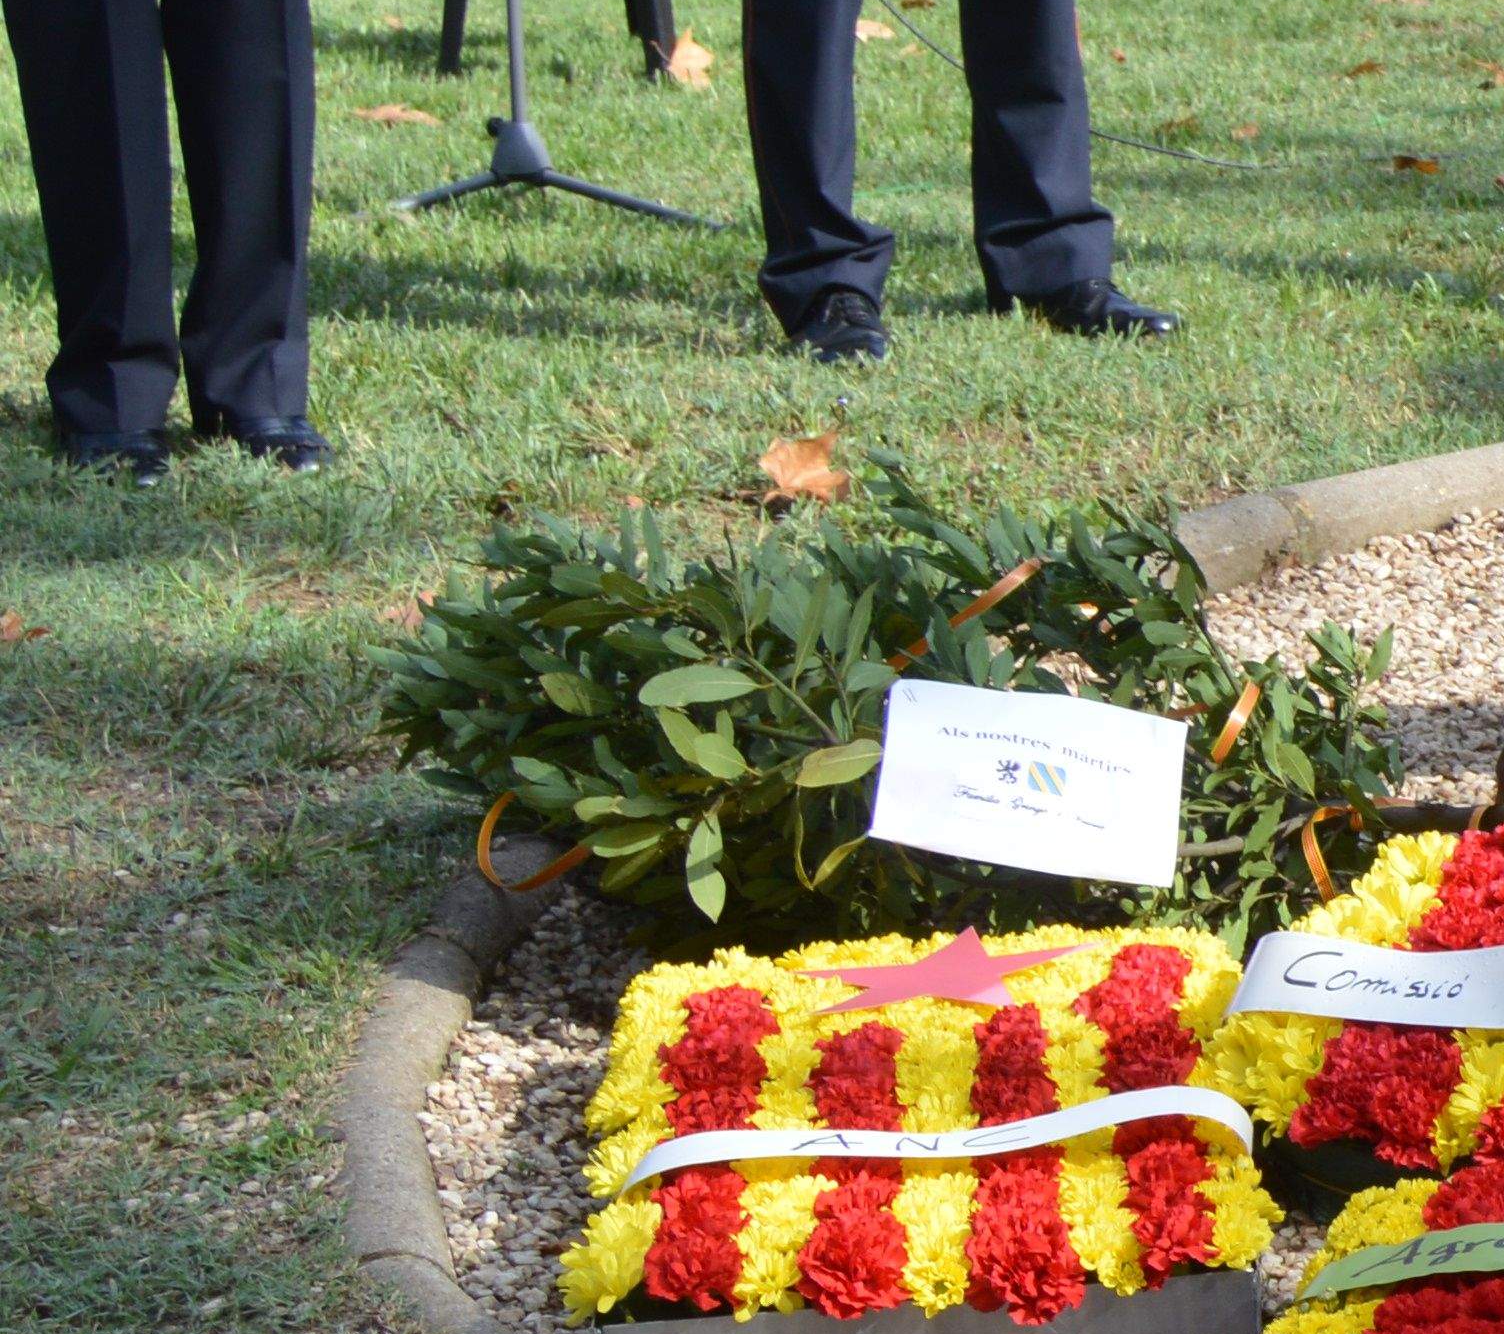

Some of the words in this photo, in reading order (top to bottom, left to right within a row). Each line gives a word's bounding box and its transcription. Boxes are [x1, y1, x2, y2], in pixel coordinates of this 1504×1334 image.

[937, 725, 970, 739] Als
[975, 730, 1052, 751] nostres
[1282, 950, 1470, 1000] Comissió
